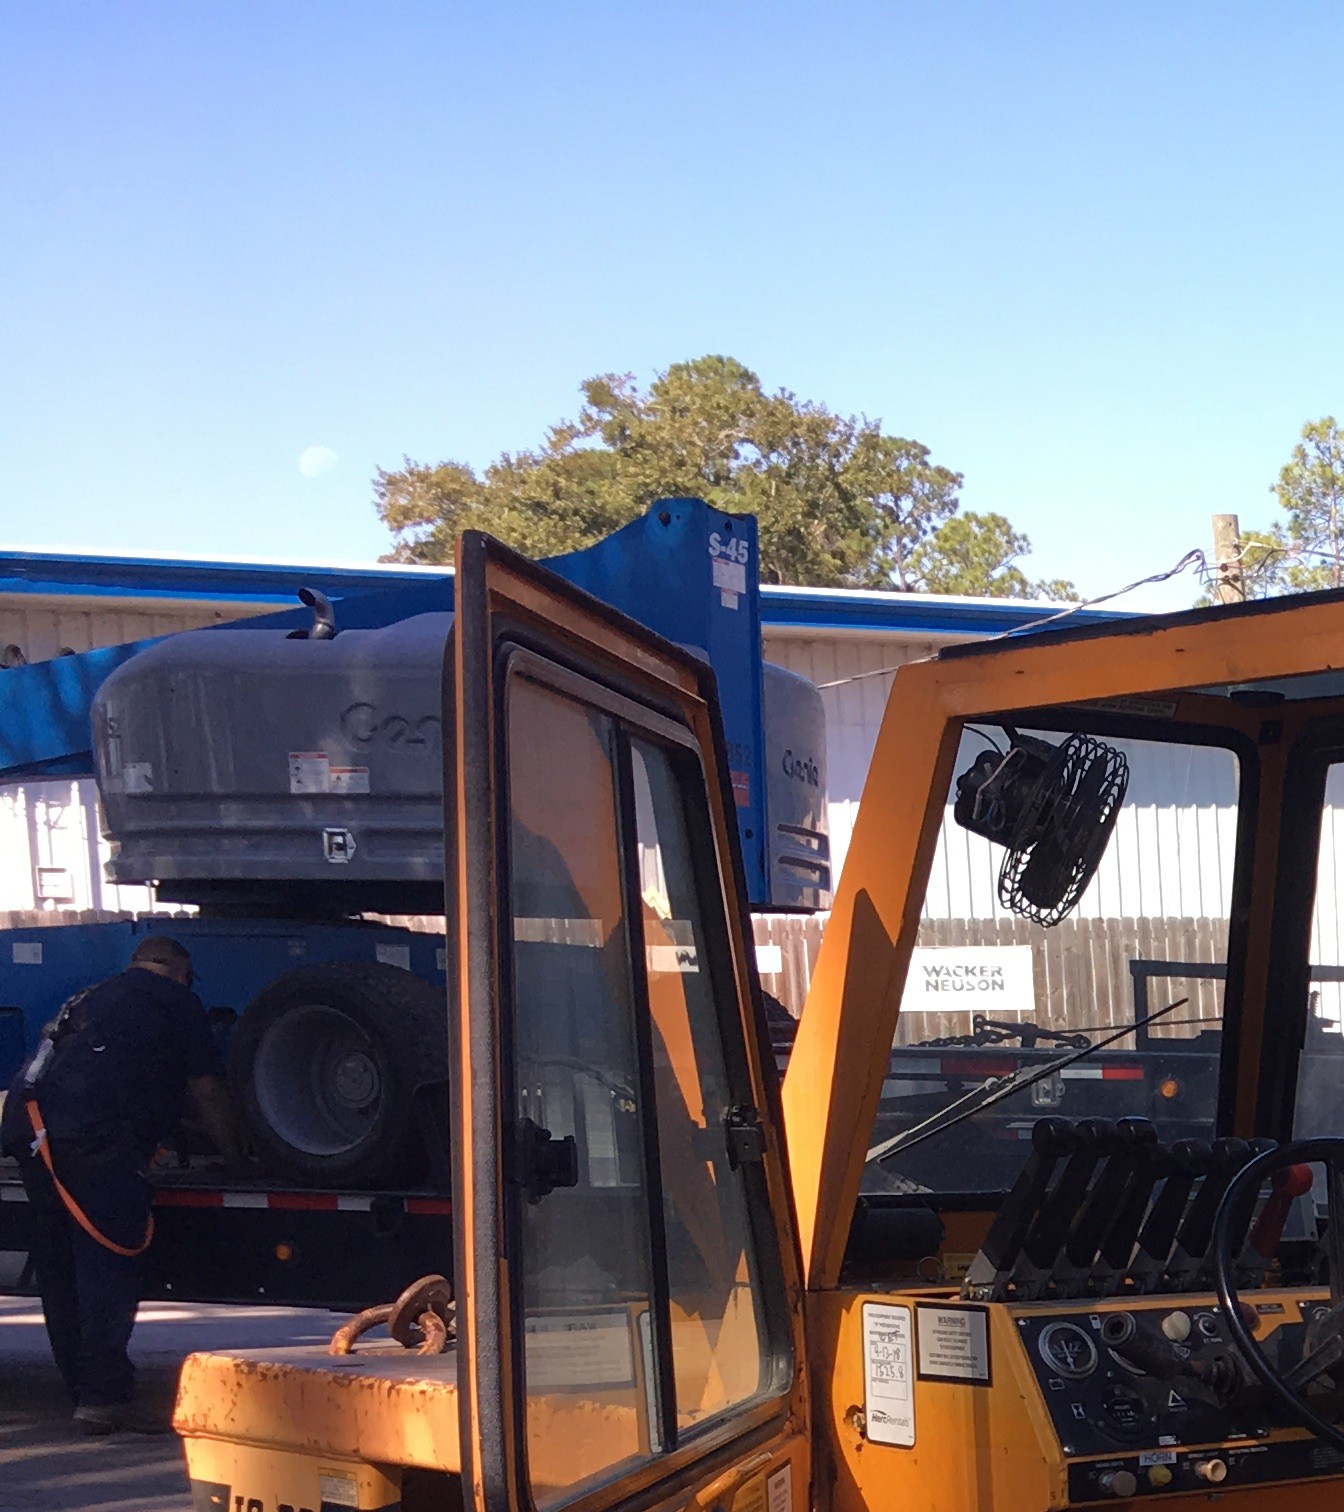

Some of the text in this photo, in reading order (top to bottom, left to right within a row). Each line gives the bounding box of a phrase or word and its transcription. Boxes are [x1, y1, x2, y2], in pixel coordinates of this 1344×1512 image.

[708, 532, 749, 564] S-45
[922, 965, 1004, 978] WACKER
[925, 979, 1005, 992] NEUSON
